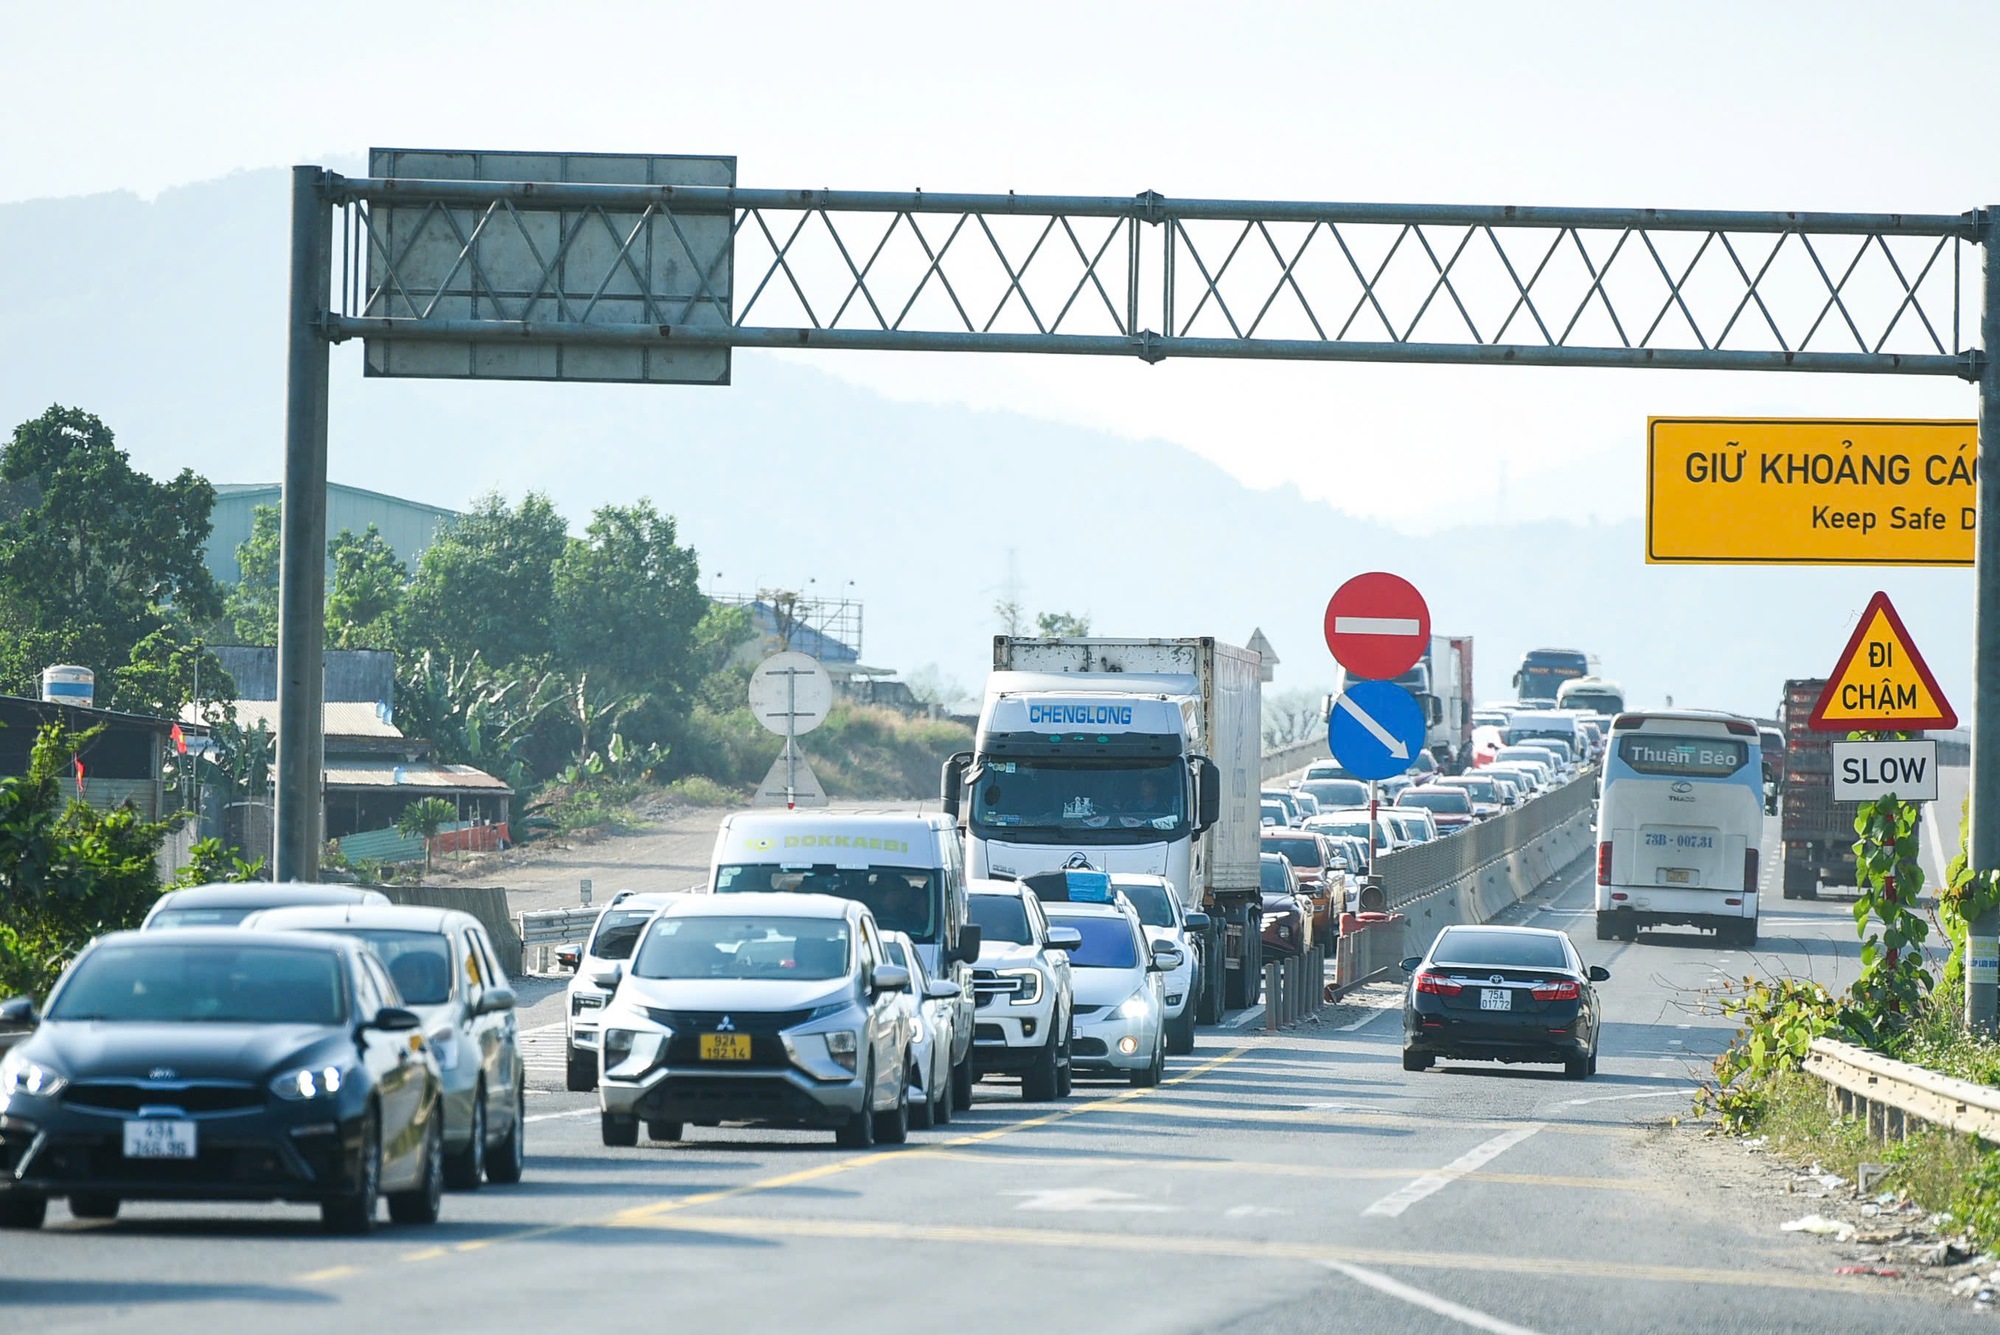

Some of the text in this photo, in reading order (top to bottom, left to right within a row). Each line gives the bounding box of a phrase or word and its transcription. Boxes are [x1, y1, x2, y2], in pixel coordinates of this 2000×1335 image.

[1686, 441, 1747, 483] GIỮ
[1760, 440, 1910, 485] KHOẢNG
[1812, 505, 1876, 534] Keep
[1890, 507, 1946, 530] Safe
[1868, 642, 1892, 667] ĐI
[1842, 677, 1917, 715] CHẬM
[1030, 705, 1132, 725] CHENGLONG
[1631, 746, 1738, 766] Thuận Béo
[1842, 757, 1927, 785] SLOW
[784, 835, 909, 854] DOKKAEBI
[1645, 833, 1667, 846] 73B
[1677, 834, 1713, 848] 007.31
[1481, 999, 1510, 1010] 017.72
[1488, 990, 1504, 1000] 75A
[714, 1035, 736, 1046] 92A
